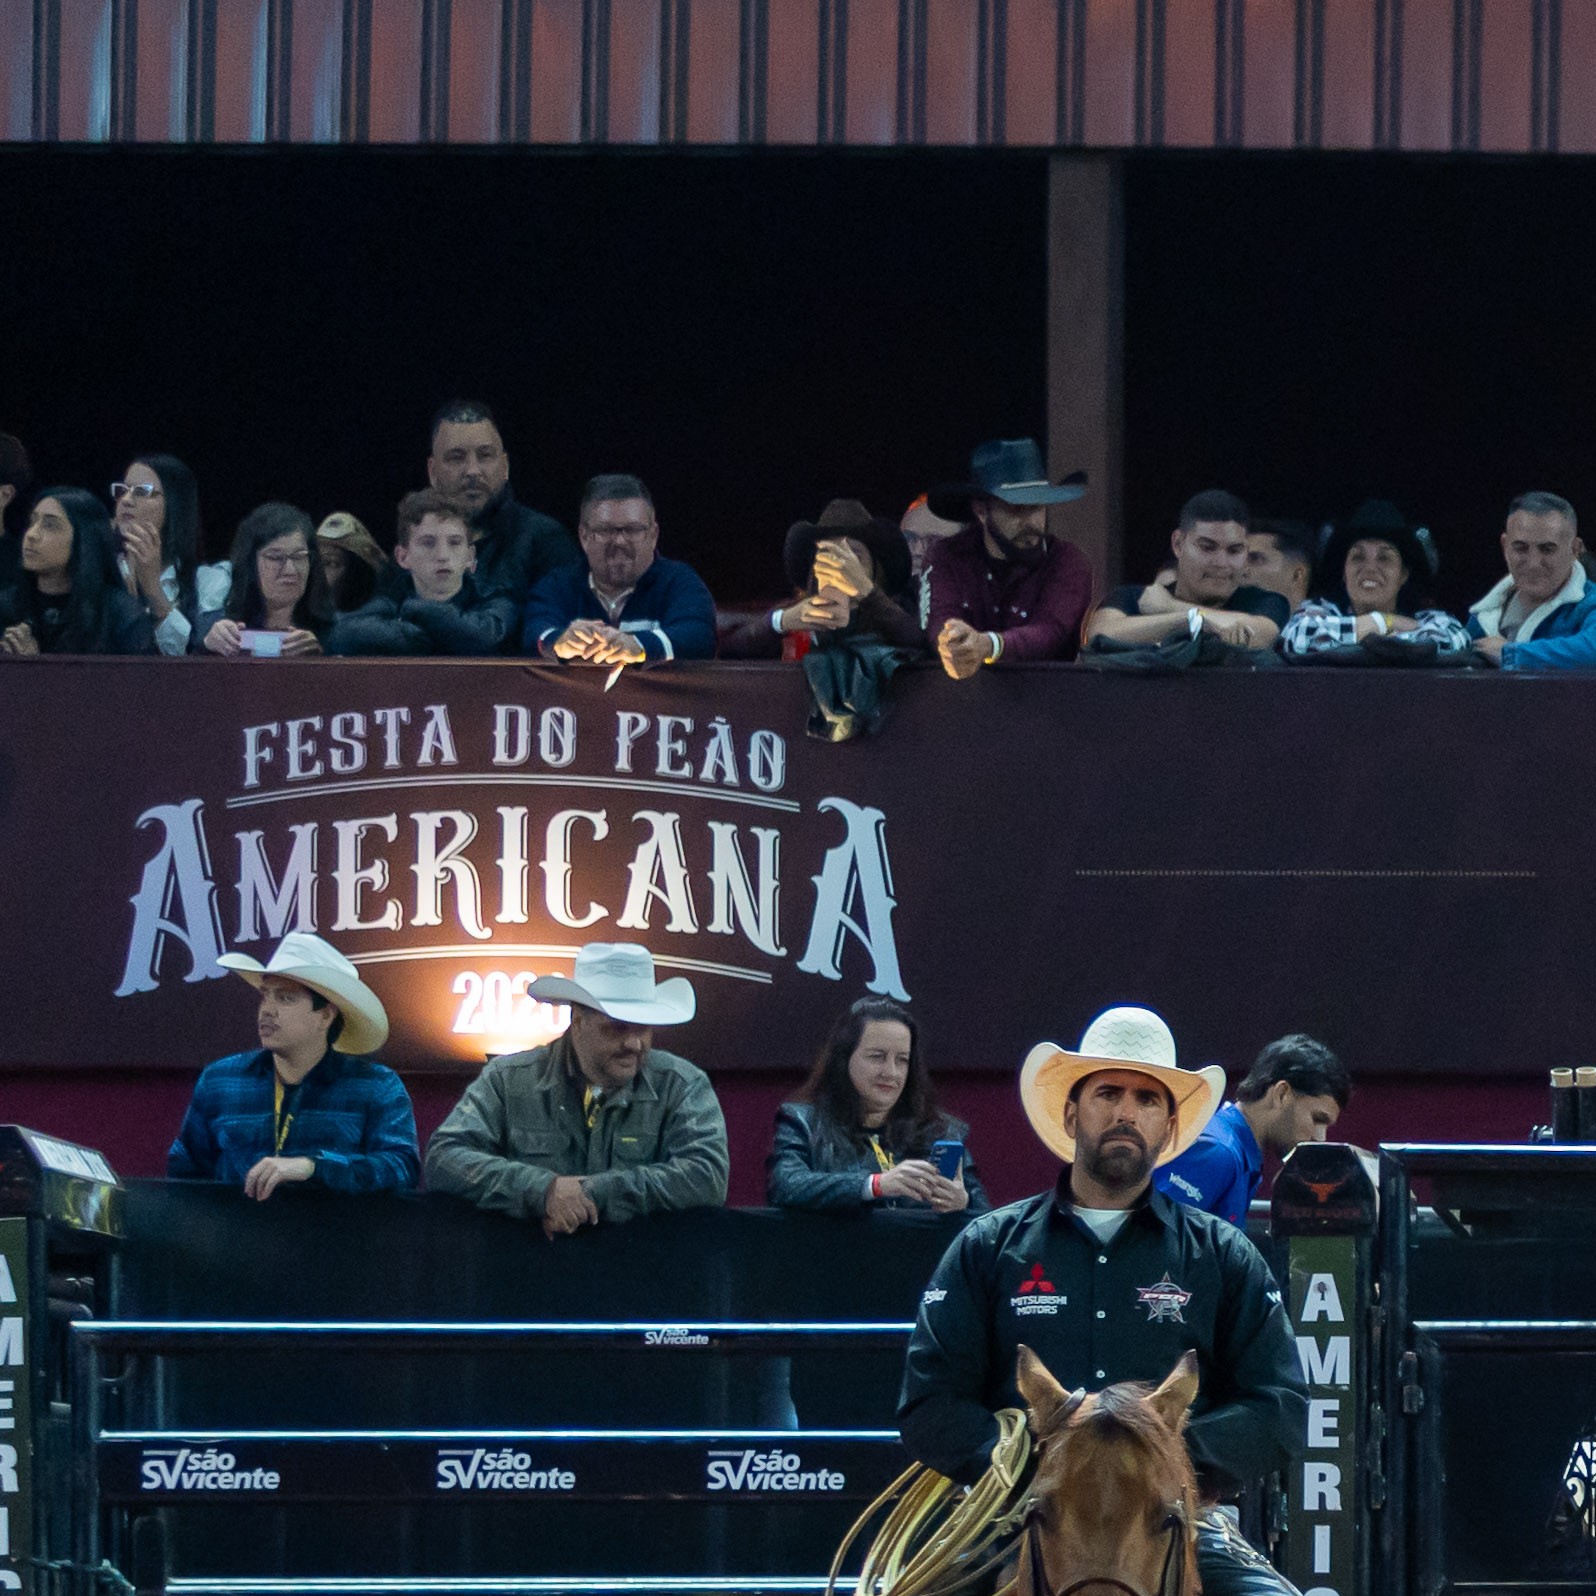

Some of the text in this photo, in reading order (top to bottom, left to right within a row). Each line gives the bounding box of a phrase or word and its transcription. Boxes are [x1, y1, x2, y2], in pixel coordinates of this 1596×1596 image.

[243, 704, 788, 793] FESTA DO PEÃO
[113, 797, 913, 1002] AMERICANA
[1010, 1295, 1068, 1306] MITSUBISHI
[1016, 1305, 1058, 1316] MOTORS
[141, 1449, 191, 1490] SV
[188, 1448, 236, 1470] são
[437, 1449, 487, 1490] SV
[483, 1448, 531, 1470] são
[707, 1449, 756, 1491] SV
[753, 1448, 800, 1470] são
[182, 1470, 280, 1490] vicente
[478, 1470, 575, 1490] vicente
[747, 1470, 844, 1491] vicente
